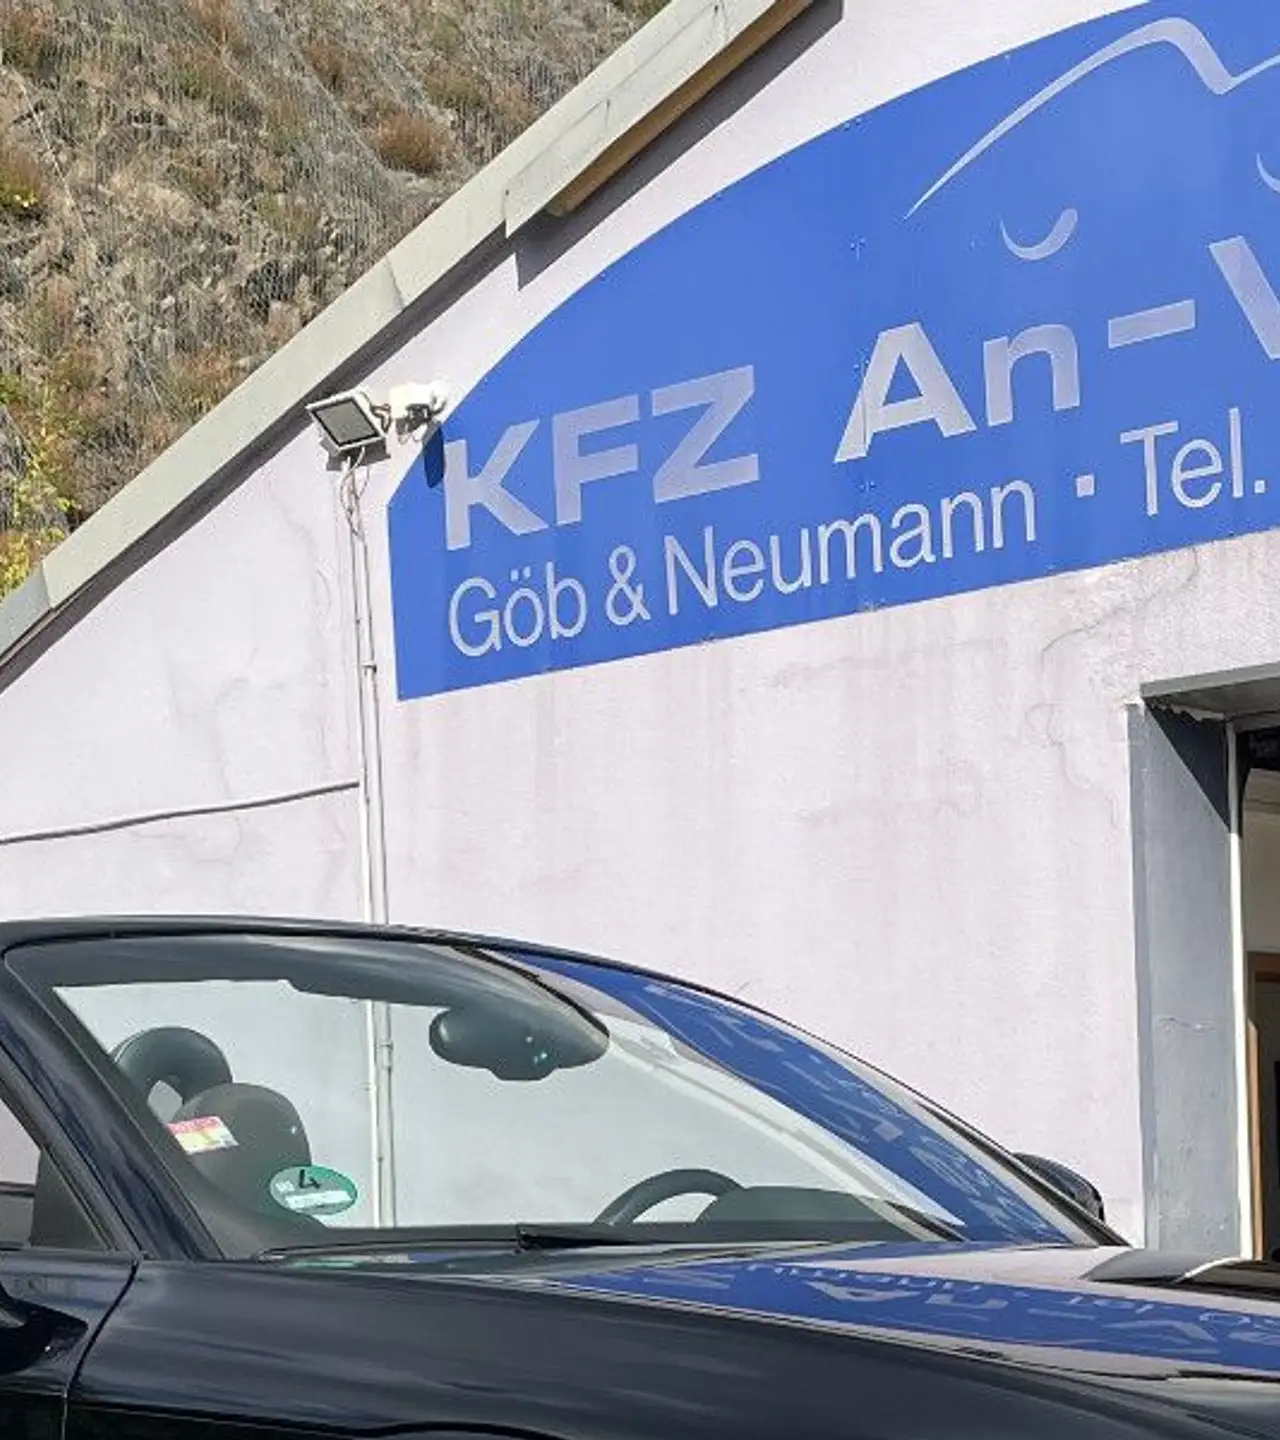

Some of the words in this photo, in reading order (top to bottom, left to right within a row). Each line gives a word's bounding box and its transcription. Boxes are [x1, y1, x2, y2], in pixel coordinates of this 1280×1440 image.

[444, 364, 761, 552] KFZ
[447, 560, 587, 658] Göb
[604, 543, 650, 629] &
[664, 477, 1037, 616] Neumann
[1122, 407, 1267, 518] Tel.
